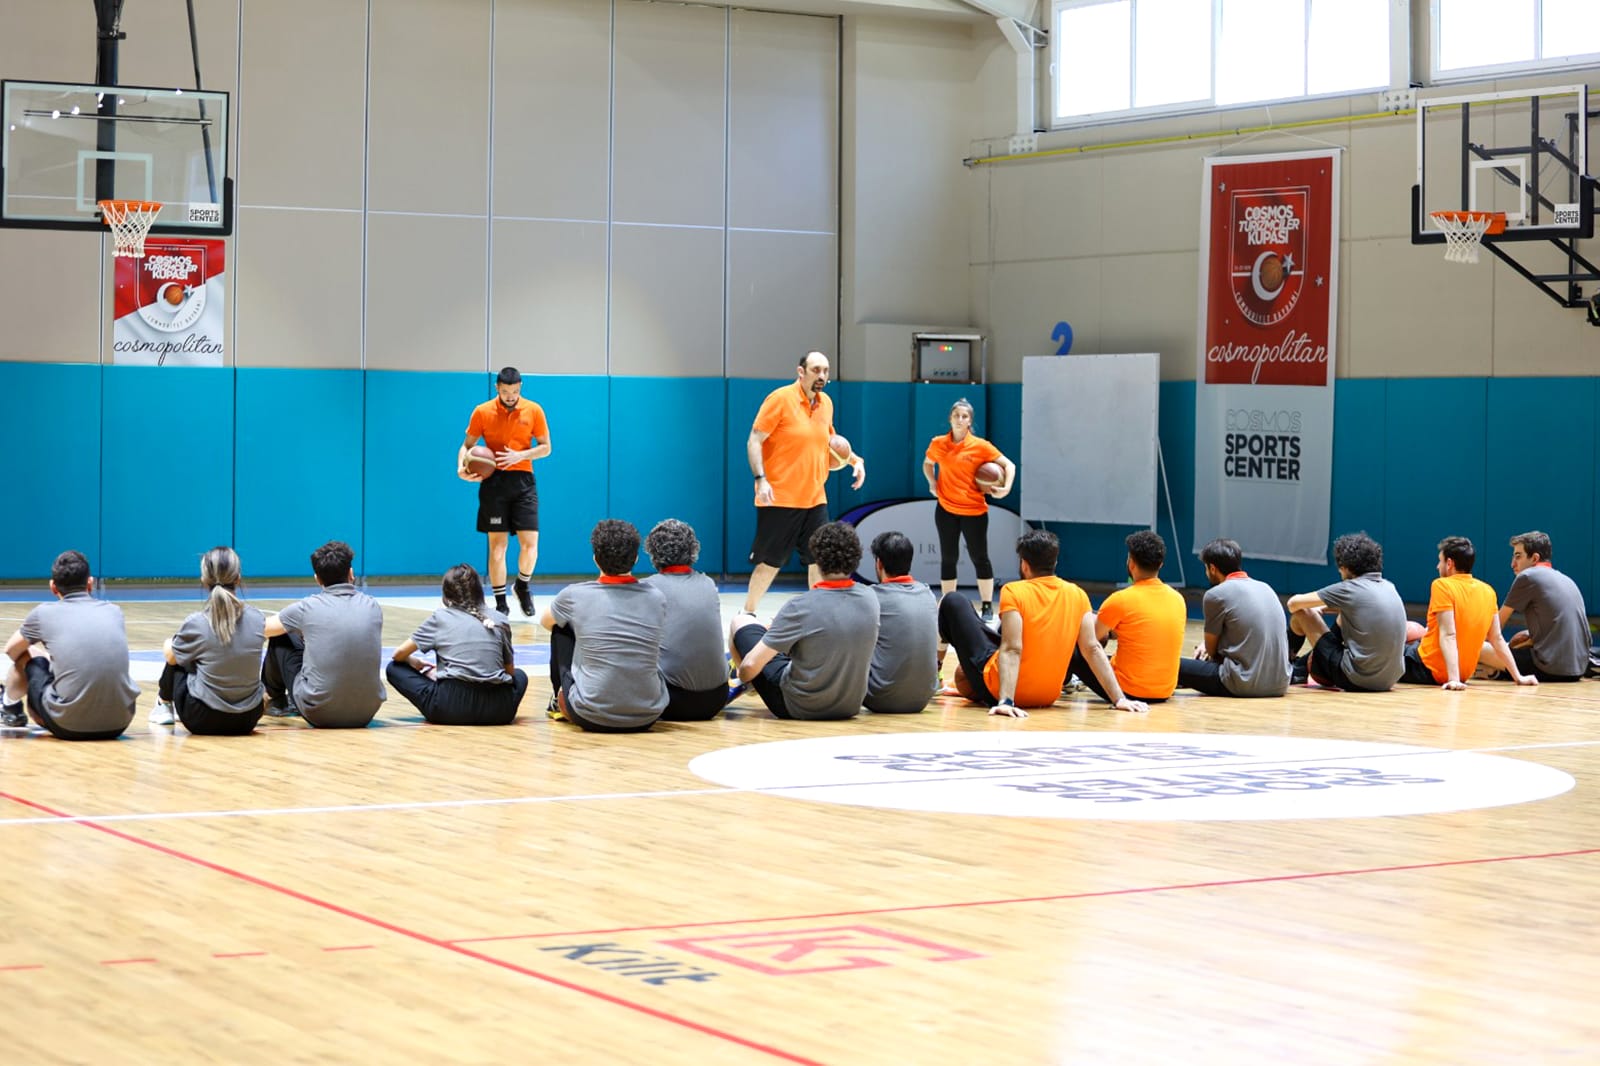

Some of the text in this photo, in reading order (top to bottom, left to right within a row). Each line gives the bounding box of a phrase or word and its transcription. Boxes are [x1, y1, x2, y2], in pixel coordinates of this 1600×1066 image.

[190, 208, 219, 216] SPORTS
[1245, 205, 1294, 221] COSMOS
[149, 255, 192, 265] COSMOS
[113, 333, 224, 367] cosmopolitan
[1051, 321, 1073, 356] 2
[1208, 329, 1328, 385] cosmopolitan
[1225, 409, 1302, 433] COSMOS
[1225, 433, 1301, 458] SPORTS
[1224, 455, 1300, 481] CENTER
[833, 742, 1201, 764] SPORTS
[882, 750, 1257, 772] CENTER
[996, 766, 1383, 793] CENTER
[1056, 773, 1447, 803] SPORTS
